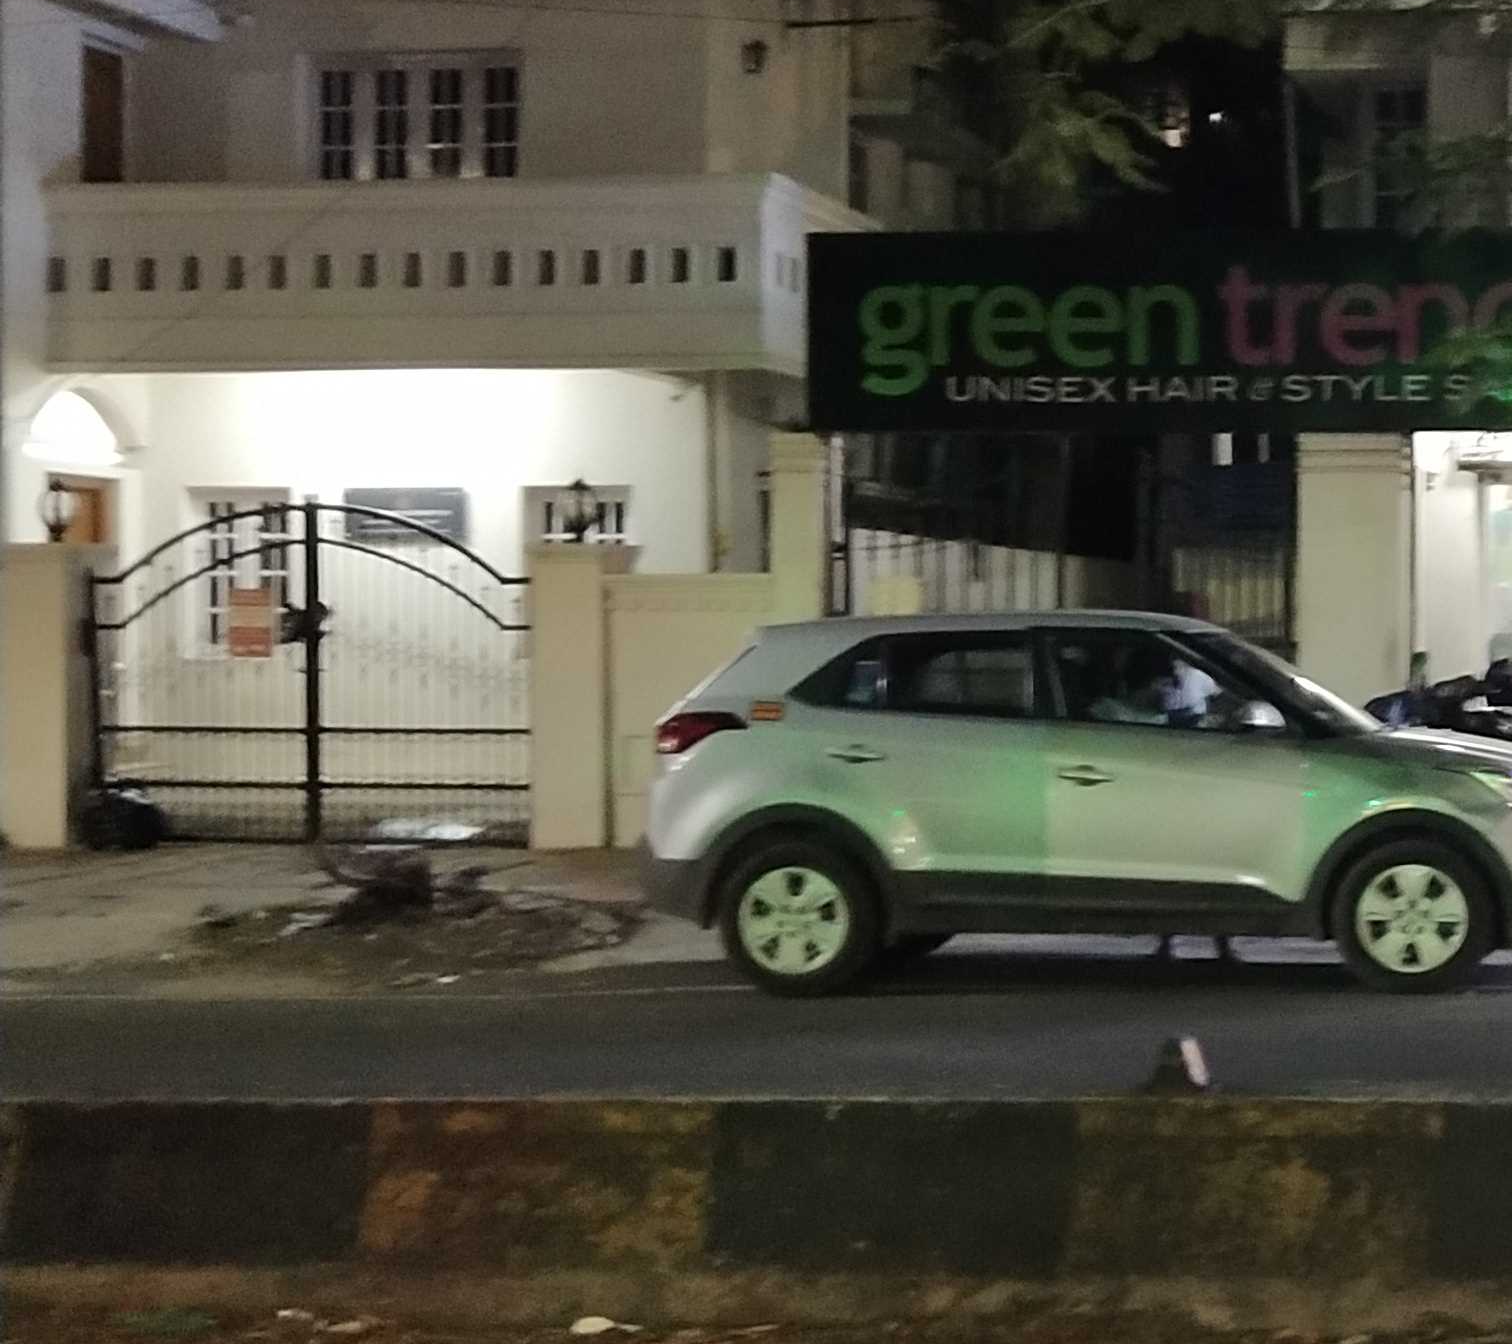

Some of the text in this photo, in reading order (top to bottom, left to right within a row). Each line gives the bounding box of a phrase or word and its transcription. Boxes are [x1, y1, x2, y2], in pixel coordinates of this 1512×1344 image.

[860, 283, 1199, 396] green
[944, 374, 1118, 404] UNISEX
[1127, 374, 1238, 404] HAIR
[1280, 373, 1432, 403] STYLE
